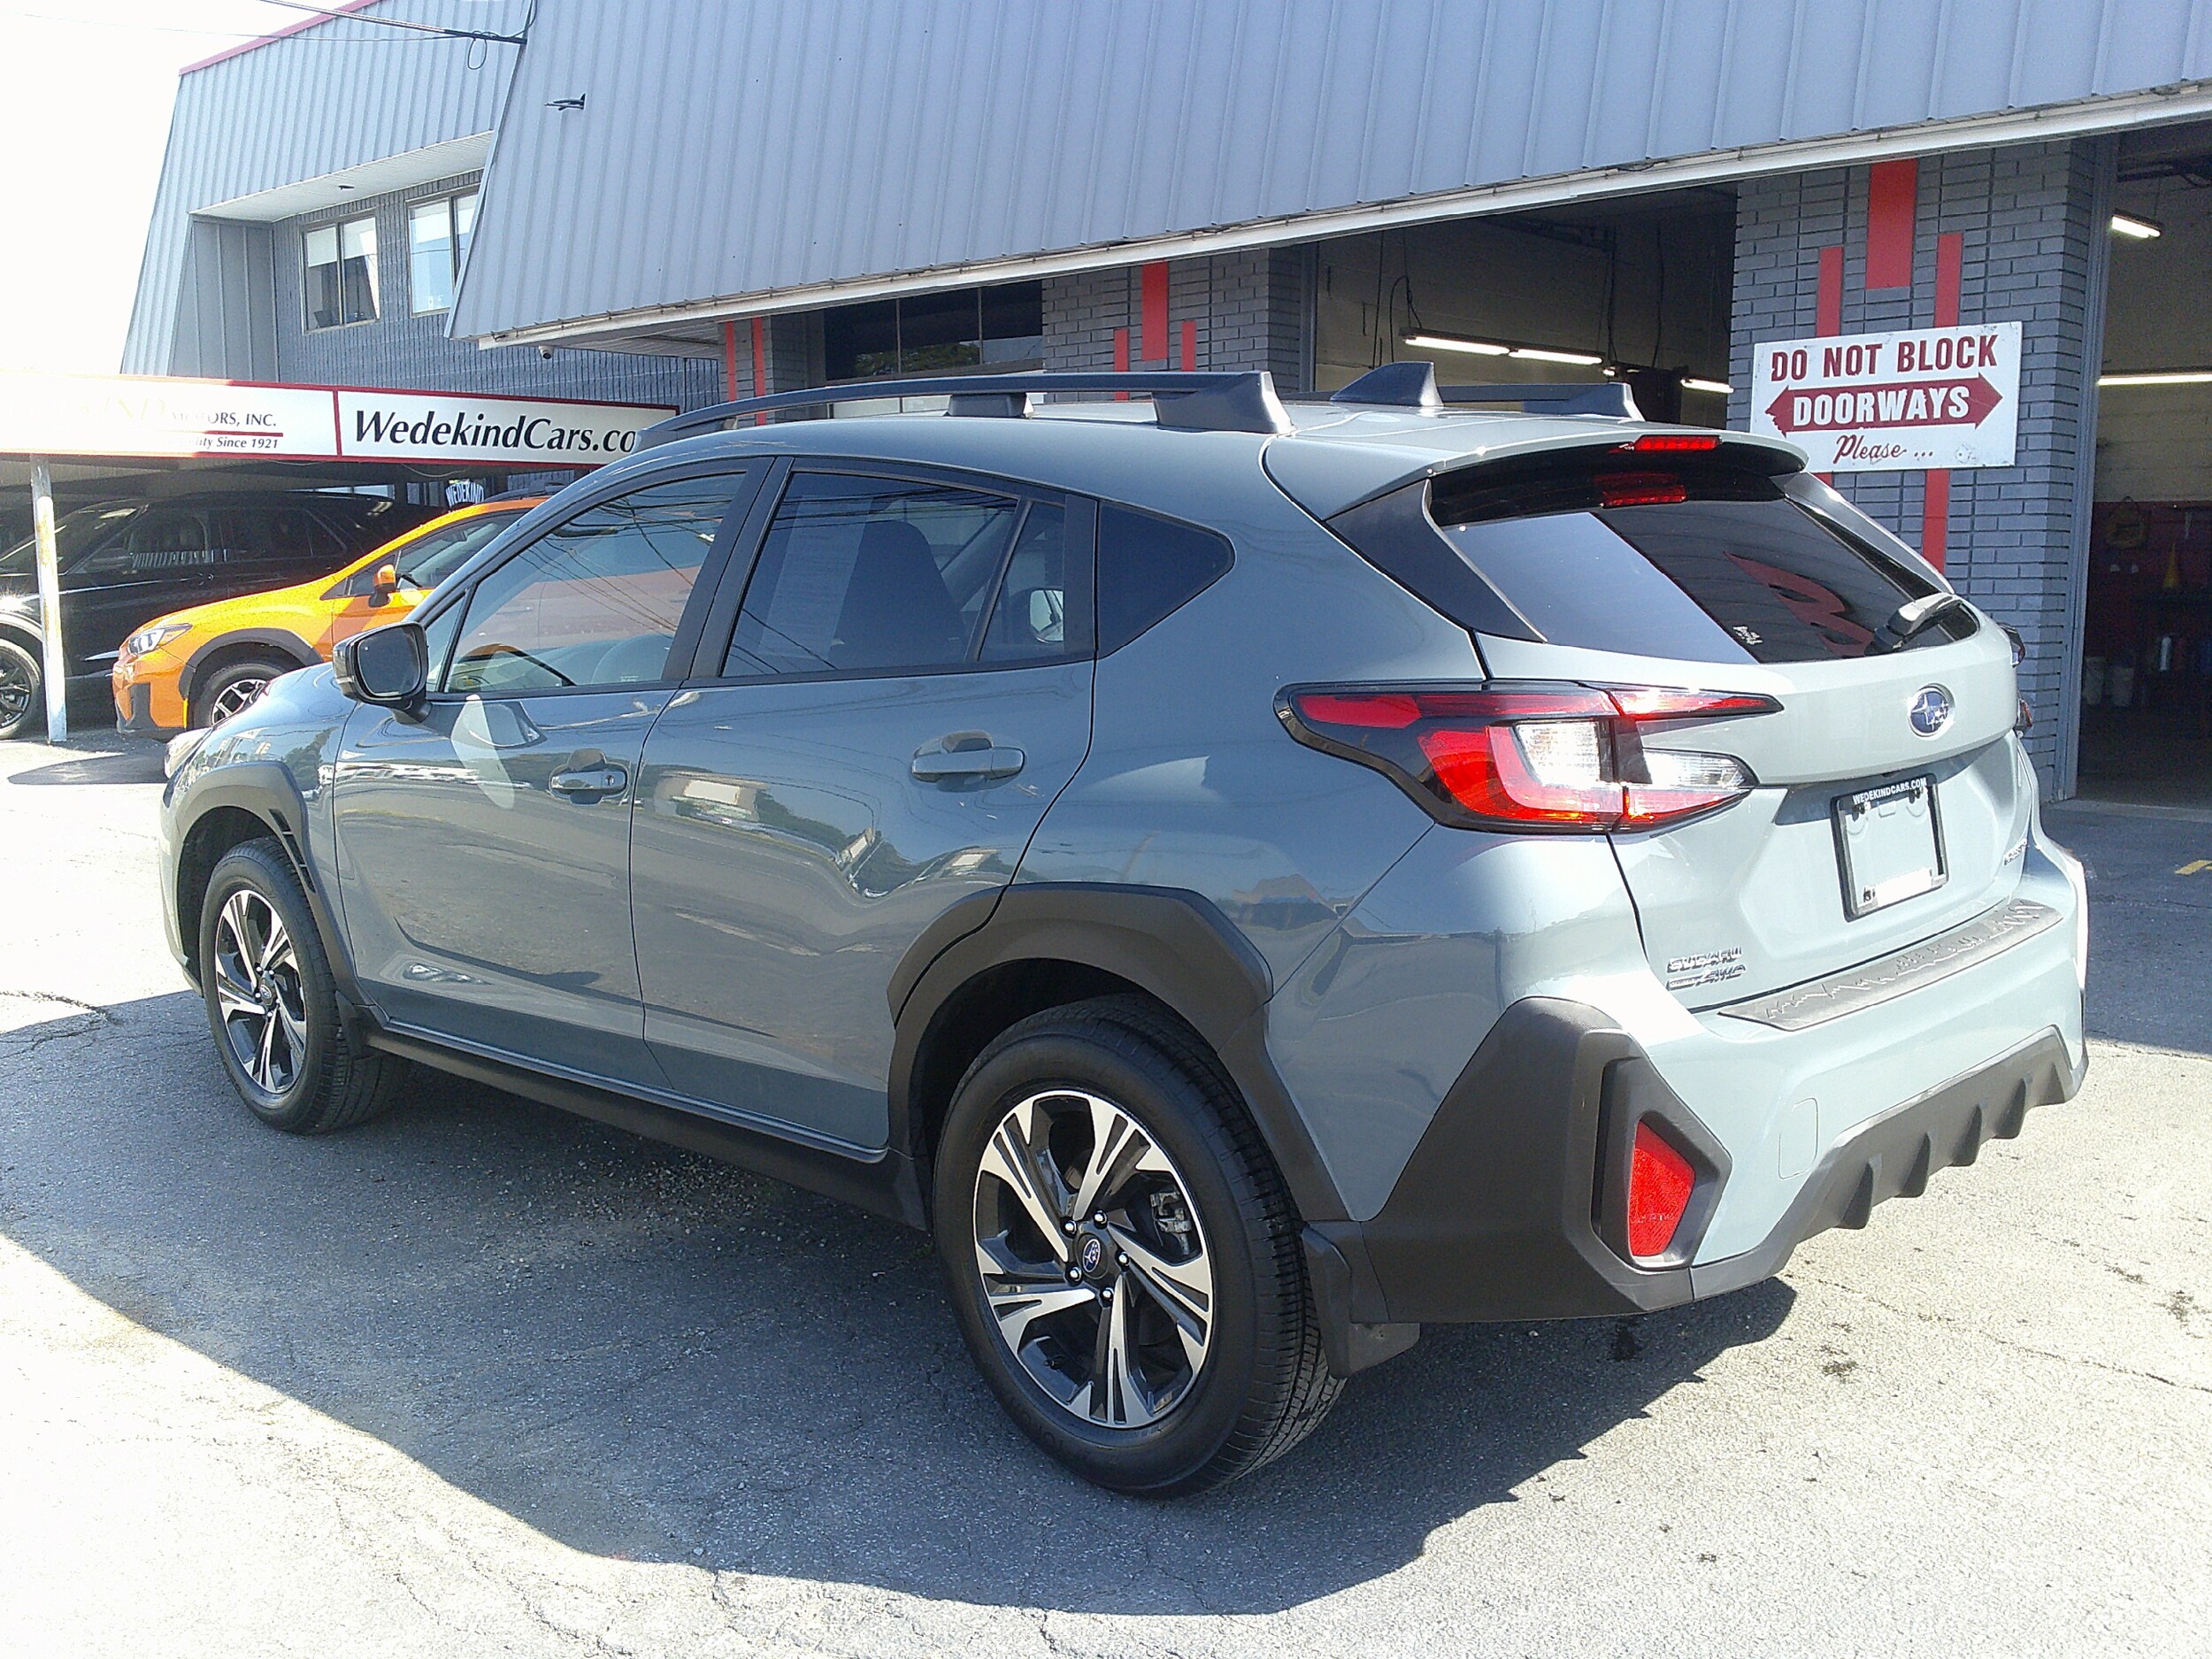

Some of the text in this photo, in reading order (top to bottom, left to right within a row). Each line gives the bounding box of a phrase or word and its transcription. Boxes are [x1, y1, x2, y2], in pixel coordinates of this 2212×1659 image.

[1771, 334, 1999, 380] DO NOT BLOCK
[172, 411, 277, 426] MORS, INC.
[1793, 386, 1970, 426] DOORWAYS
[217, 436, 248, 449] Since
[251, 438, 279, 449] 1921
[1832, 434, 1908, 465] Please
[445, 480, 485, 507] WEDEKIND
[1852, 777, 1927, 805] WEDEKINDCARS.COM
